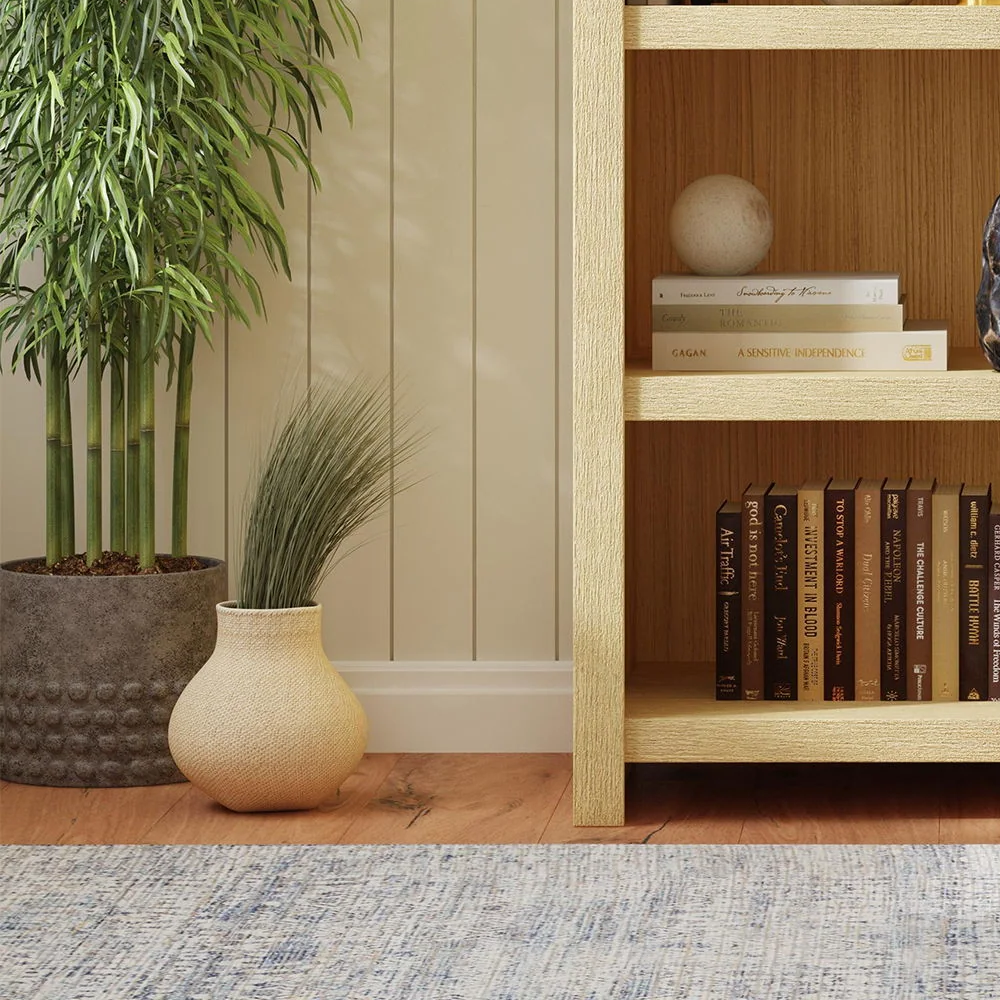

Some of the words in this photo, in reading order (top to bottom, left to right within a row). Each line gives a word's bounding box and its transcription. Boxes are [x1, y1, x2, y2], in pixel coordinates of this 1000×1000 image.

[786, 288, 796, 297] to
[672, 350, 706, 358] GAGAN
[738, 348, 744, 358] A
[746, 348, 791, 358] SENSITIVE
[794, 348, 866, 358] INDEPENDENCE
[745, 500, 762, 526] god
[836, 499, 844, 513] TO
[970, 501, 978, 529] william
[720, 528, 734, 547] Air
[750, 529, 760, 540] is
[774, 504, 787, 563] Camelot's
[836, 514, 844, 538] STOP
[749, 544, 760, 568] not
[804, 526, 817, 589] INVESTMENT
[893, 529, 901, 583] NAPOLEON
[916, 542, 924, 558] THE
[969, 540, 978, 558] dietz
[720, 548, 734, 585] Traffic
[835, 548, 844, 594] WARLORD
[863, 553, 872, 575] Dual
[749, 571, 760, 601] here
[774, 566, 788, 590] End
[916, 560, 924, 605] CHALLENGE
[804, 593, 817, 603] IN
[968, 580, 979, 613] BATTLE
[804, 607, 817, 637] BLOOD
[916, 607, 924, 640] CULTURE
[968, 616, 979, 645] HYMN
